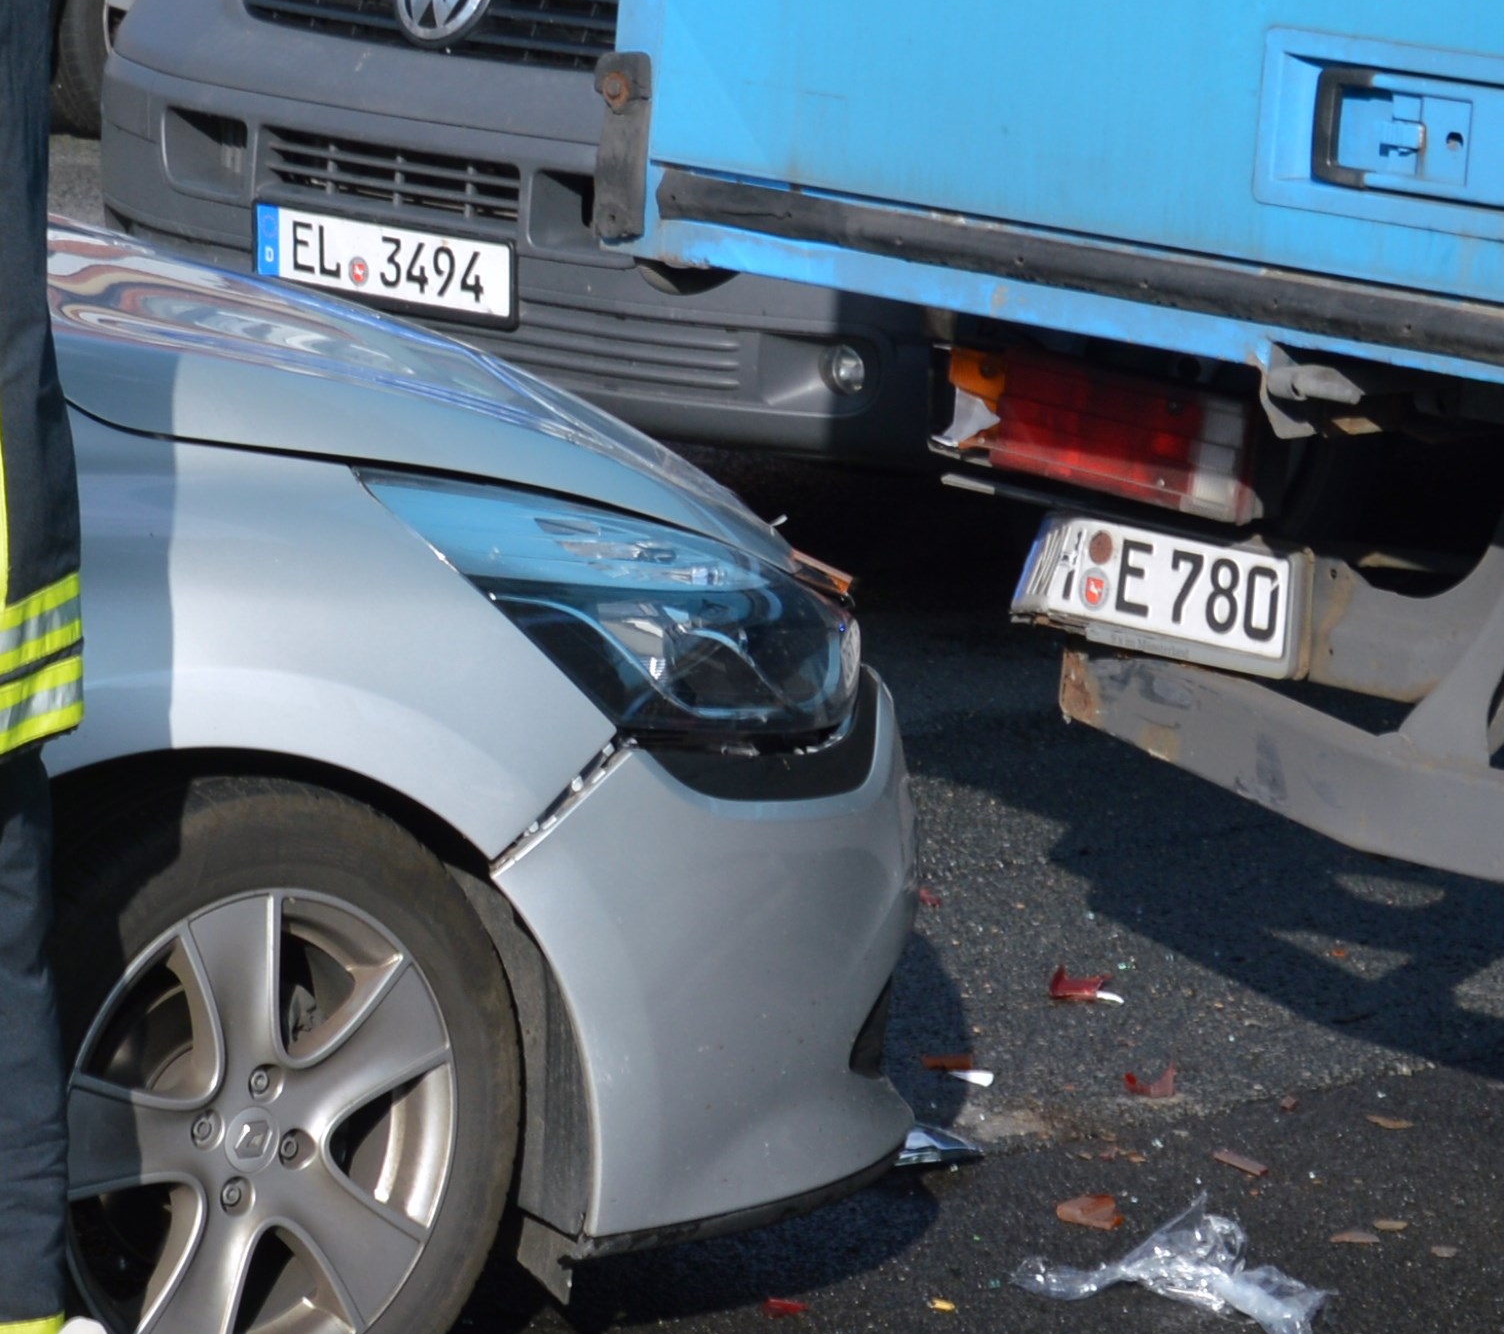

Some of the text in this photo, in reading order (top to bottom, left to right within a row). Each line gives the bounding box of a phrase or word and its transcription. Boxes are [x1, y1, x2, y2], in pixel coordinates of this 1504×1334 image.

[293, 221, 341, 279] EL
[379, 234, 484, 304] 3494
[1170, 548, 1282, 643] 780
